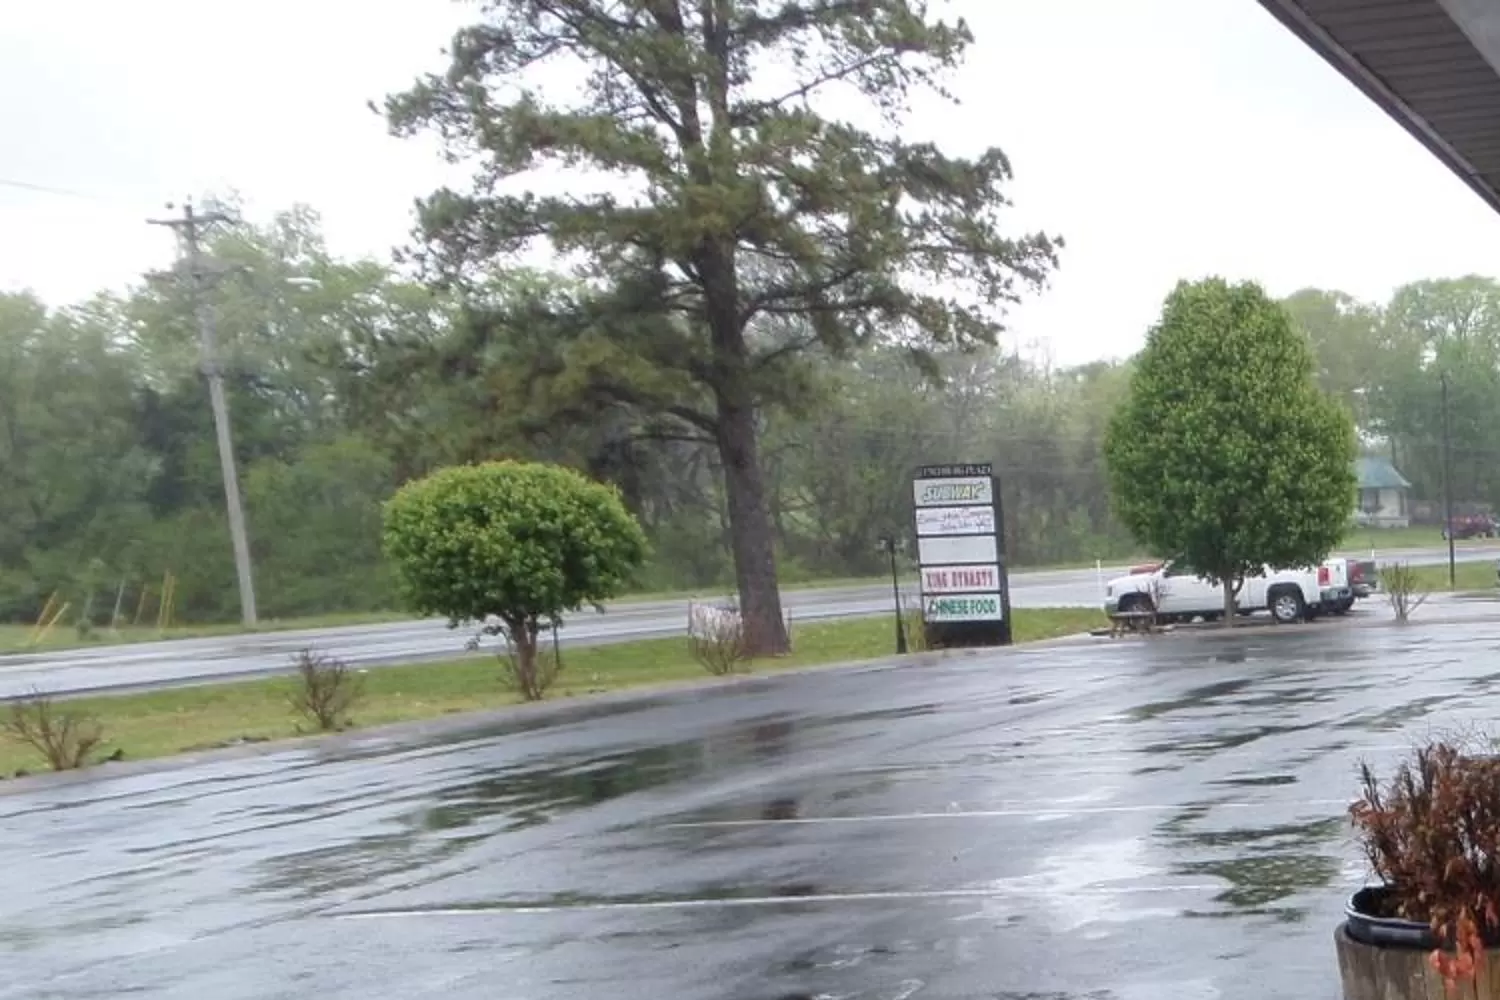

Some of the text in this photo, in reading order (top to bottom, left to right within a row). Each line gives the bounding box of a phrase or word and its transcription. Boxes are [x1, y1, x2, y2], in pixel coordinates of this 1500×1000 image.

[923, 483, 986, 502] SUBWAY
[951, 569, 994, 588] DYNASTY
[928, 597, 997, 616] CHINESE FOOD
